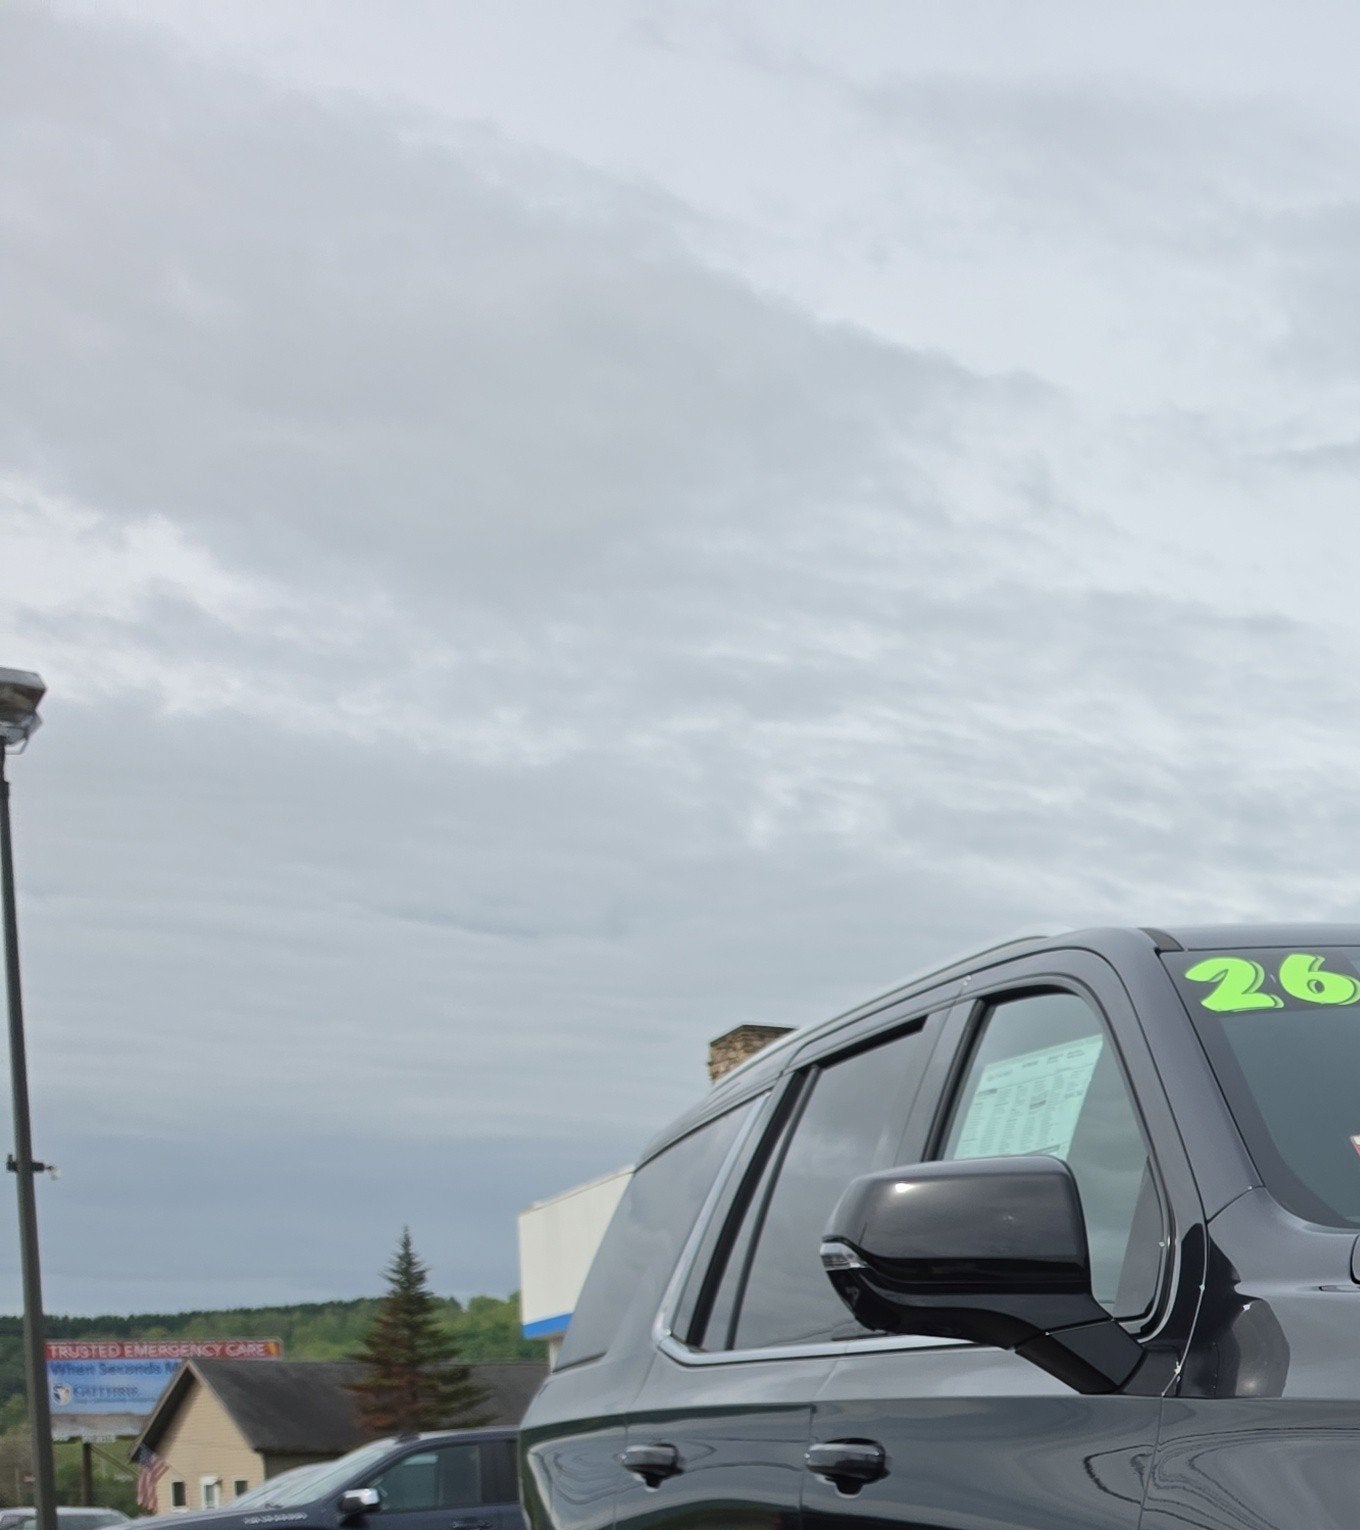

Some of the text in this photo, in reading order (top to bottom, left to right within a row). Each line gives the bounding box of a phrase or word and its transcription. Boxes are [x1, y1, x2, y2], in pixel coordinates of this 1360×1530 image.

[50, 1341, 265, 1359] TRUSTED EMERGENCY CARE
